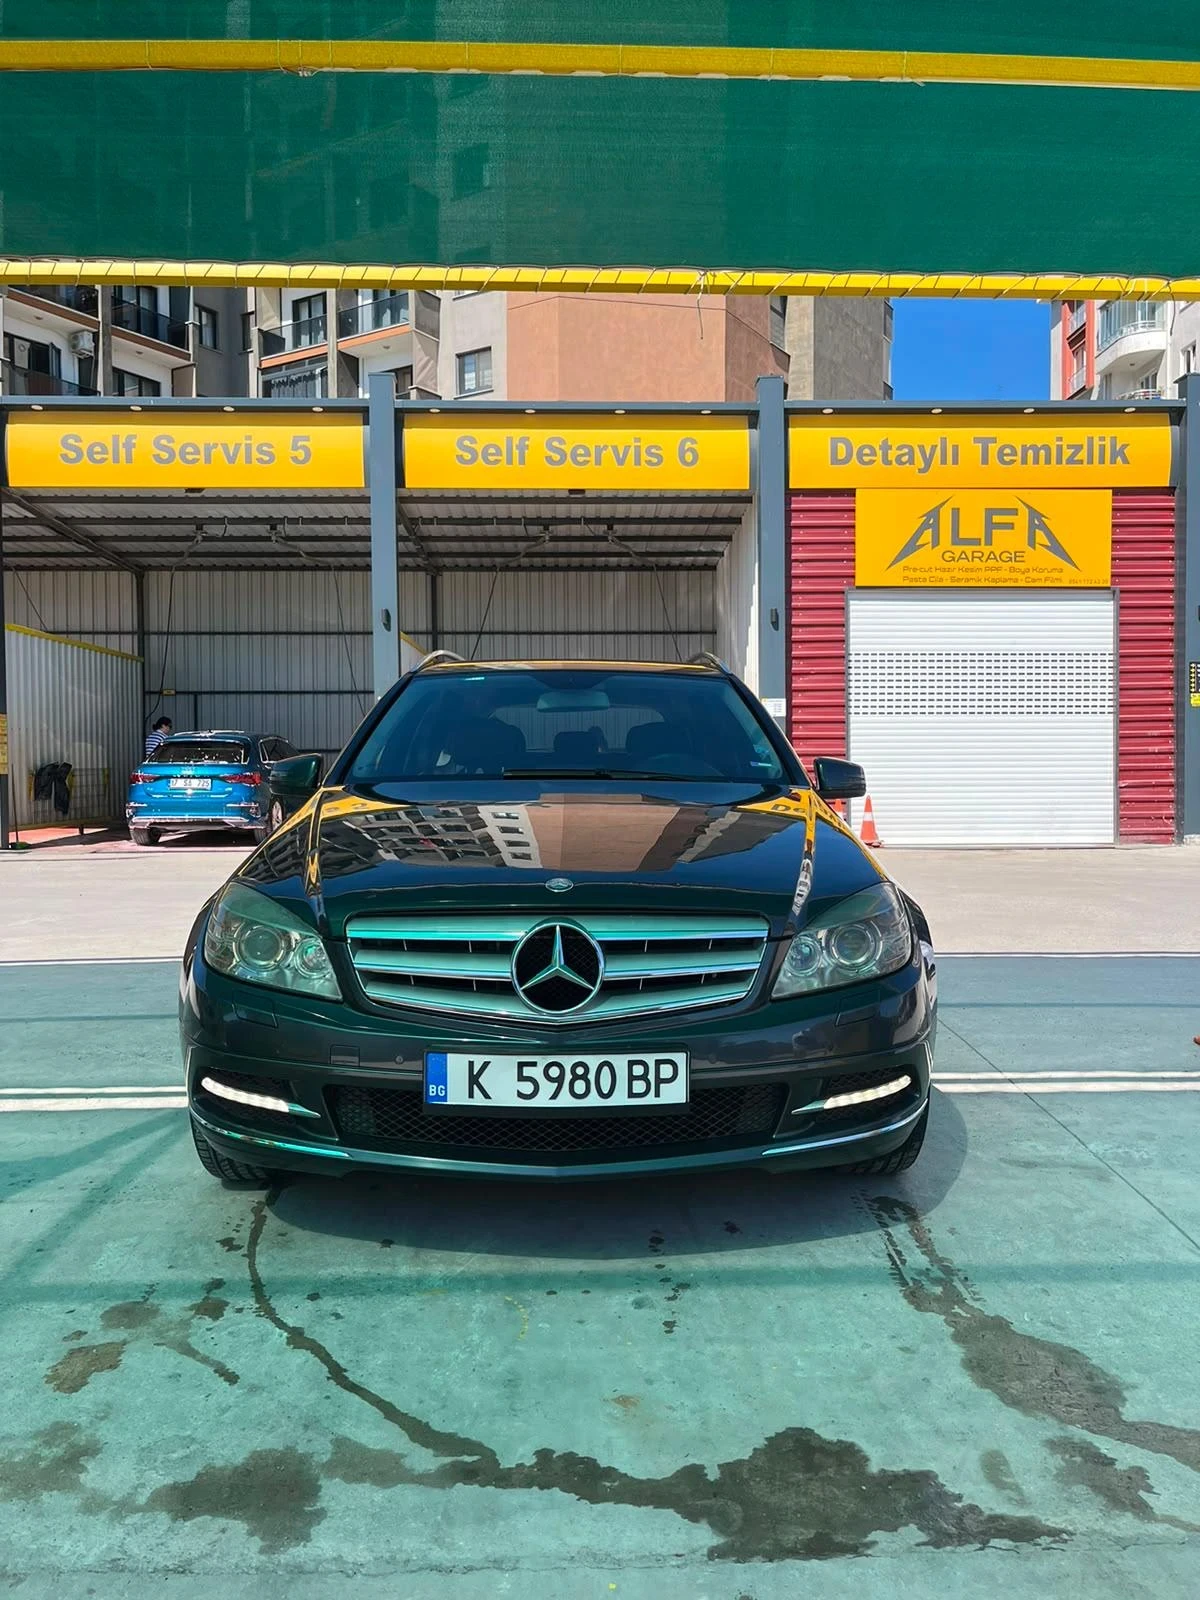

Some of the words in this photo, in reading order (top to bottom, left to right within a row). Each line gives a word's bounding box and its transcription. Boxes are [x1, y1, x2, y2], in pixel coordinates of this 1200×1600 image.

[59, 433, 138, 465] Self
[152, 434, 276, 465] Servis
[289, 435, 312, 465] 5
[455, 435, 530, 467] Self
[544, 436, 664, 467] Servis
[677, 436, 699, 468] 6
[829, 436, 960, 473] Detaylı
[973, 435, 1131, 466] Temizlik
[885, 495, 1082, 572] ALFA
[941, 550, 1026, 563] GARAGE
[958, 565, 982, 573] Kesim
[984, 565, 1002, 573] PPF
[1009, 566, 1030, 576] Boya
[1032, 566, 1063, 574] Koruma
[984, 576, 1019, 585] Kaplama
[429, 1085, 446, 1097] BG
[467, 1060, 492, 1100] K
[516, 1060, 617, 1101] 5980
[627, 1058, 679, 1099] BP
